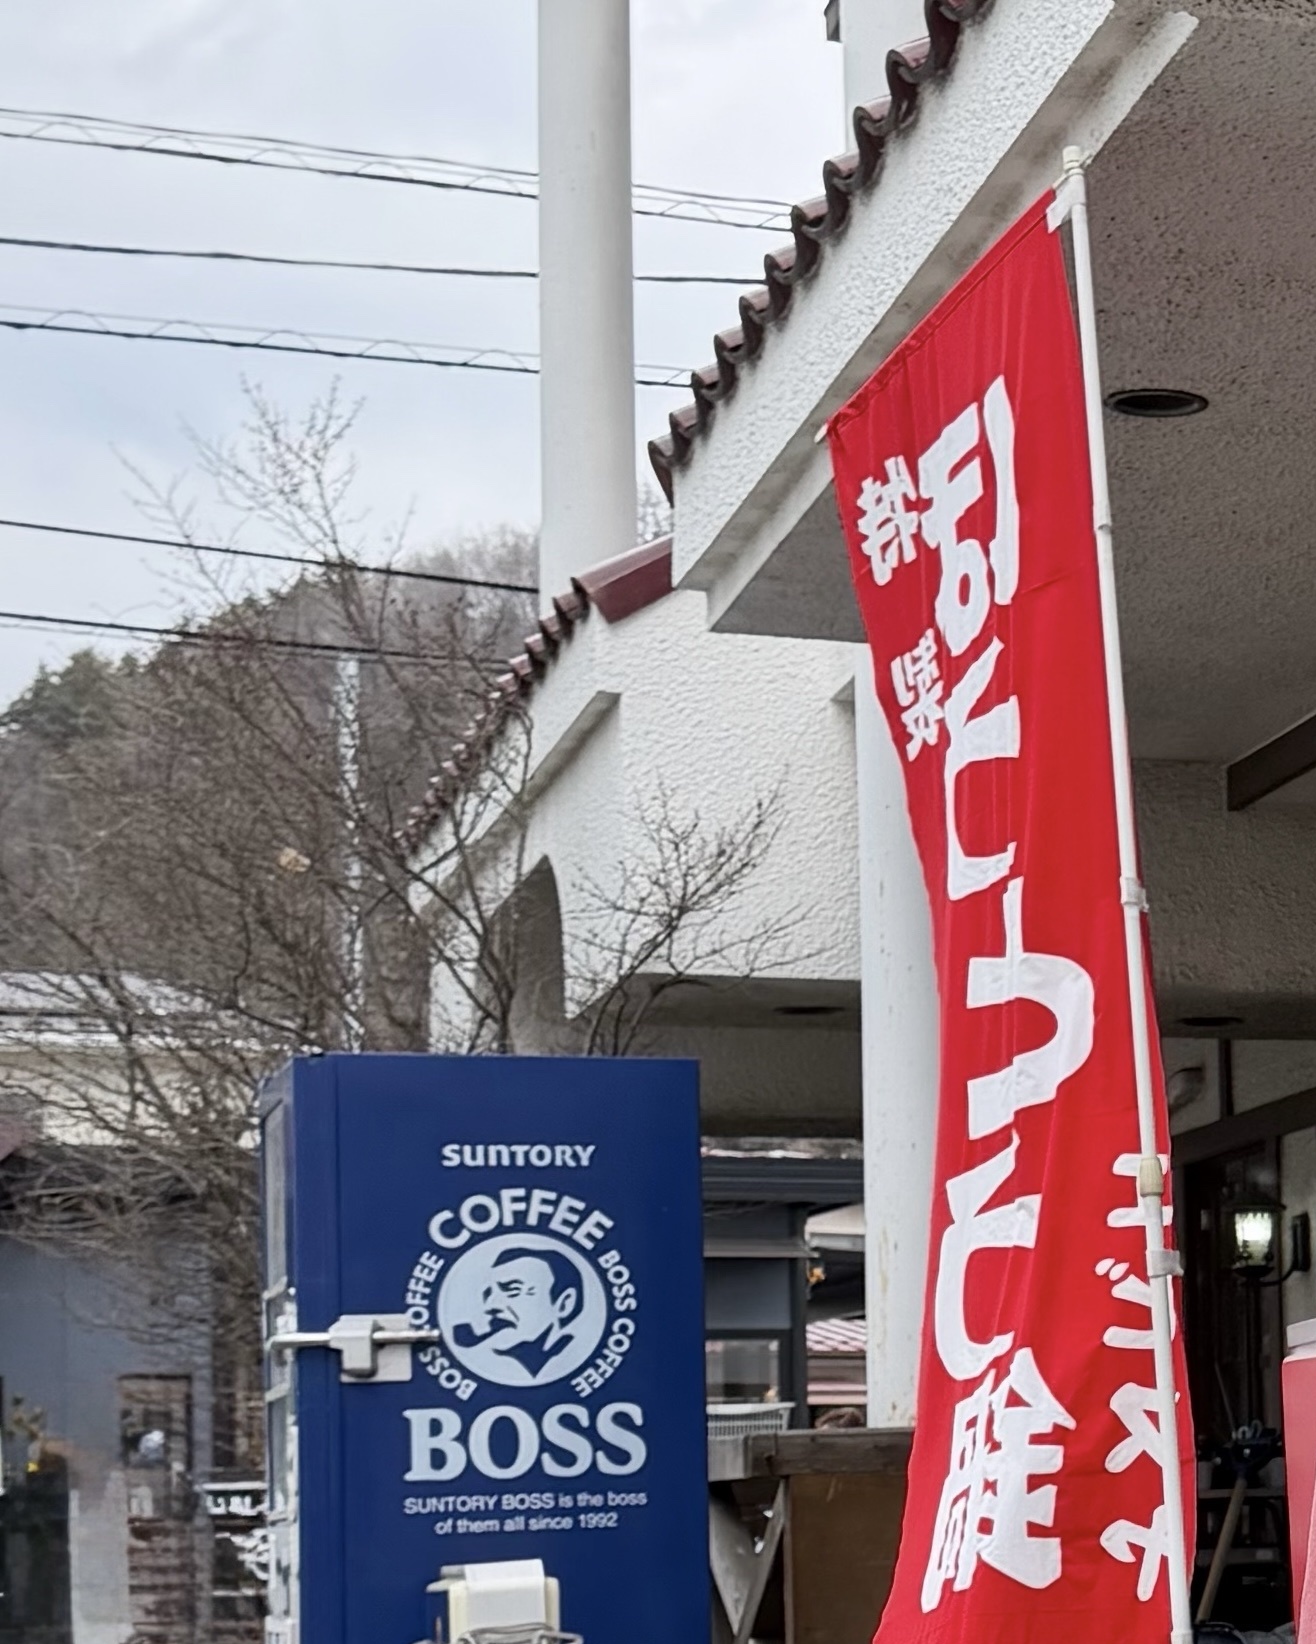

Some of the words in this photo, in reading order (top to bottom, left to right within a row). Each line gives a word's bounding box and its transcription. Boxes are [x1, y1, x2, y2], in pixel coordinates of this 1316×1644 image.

[428, 1187, 615, 1250] COFFEE
[405, 1251, 445, 1331] OFFEE
[597, 1249, 637, 1312] BOSS
[418, 1346, 478, 1401] BOSS
[570, 1317, 635, 1398] COFFEE
[403, 1402, 648, 1481] BOSS
[403, 1494, 499, 1514] SUNTORY
[501, 1493, 555, 1511] BOSS
[558, 1492, 573, 1508] is
[576, 1491, 604, 1508] the
[607, 1490, 648, 1506] boss
[434, 1518, 454, 1535] of
[456, 1517, 500, 1534] them
[503, 1515, 525, 1532] all
[528, 1513, 573, 1531] since
[579, 1512, 619, 1529] 1992
